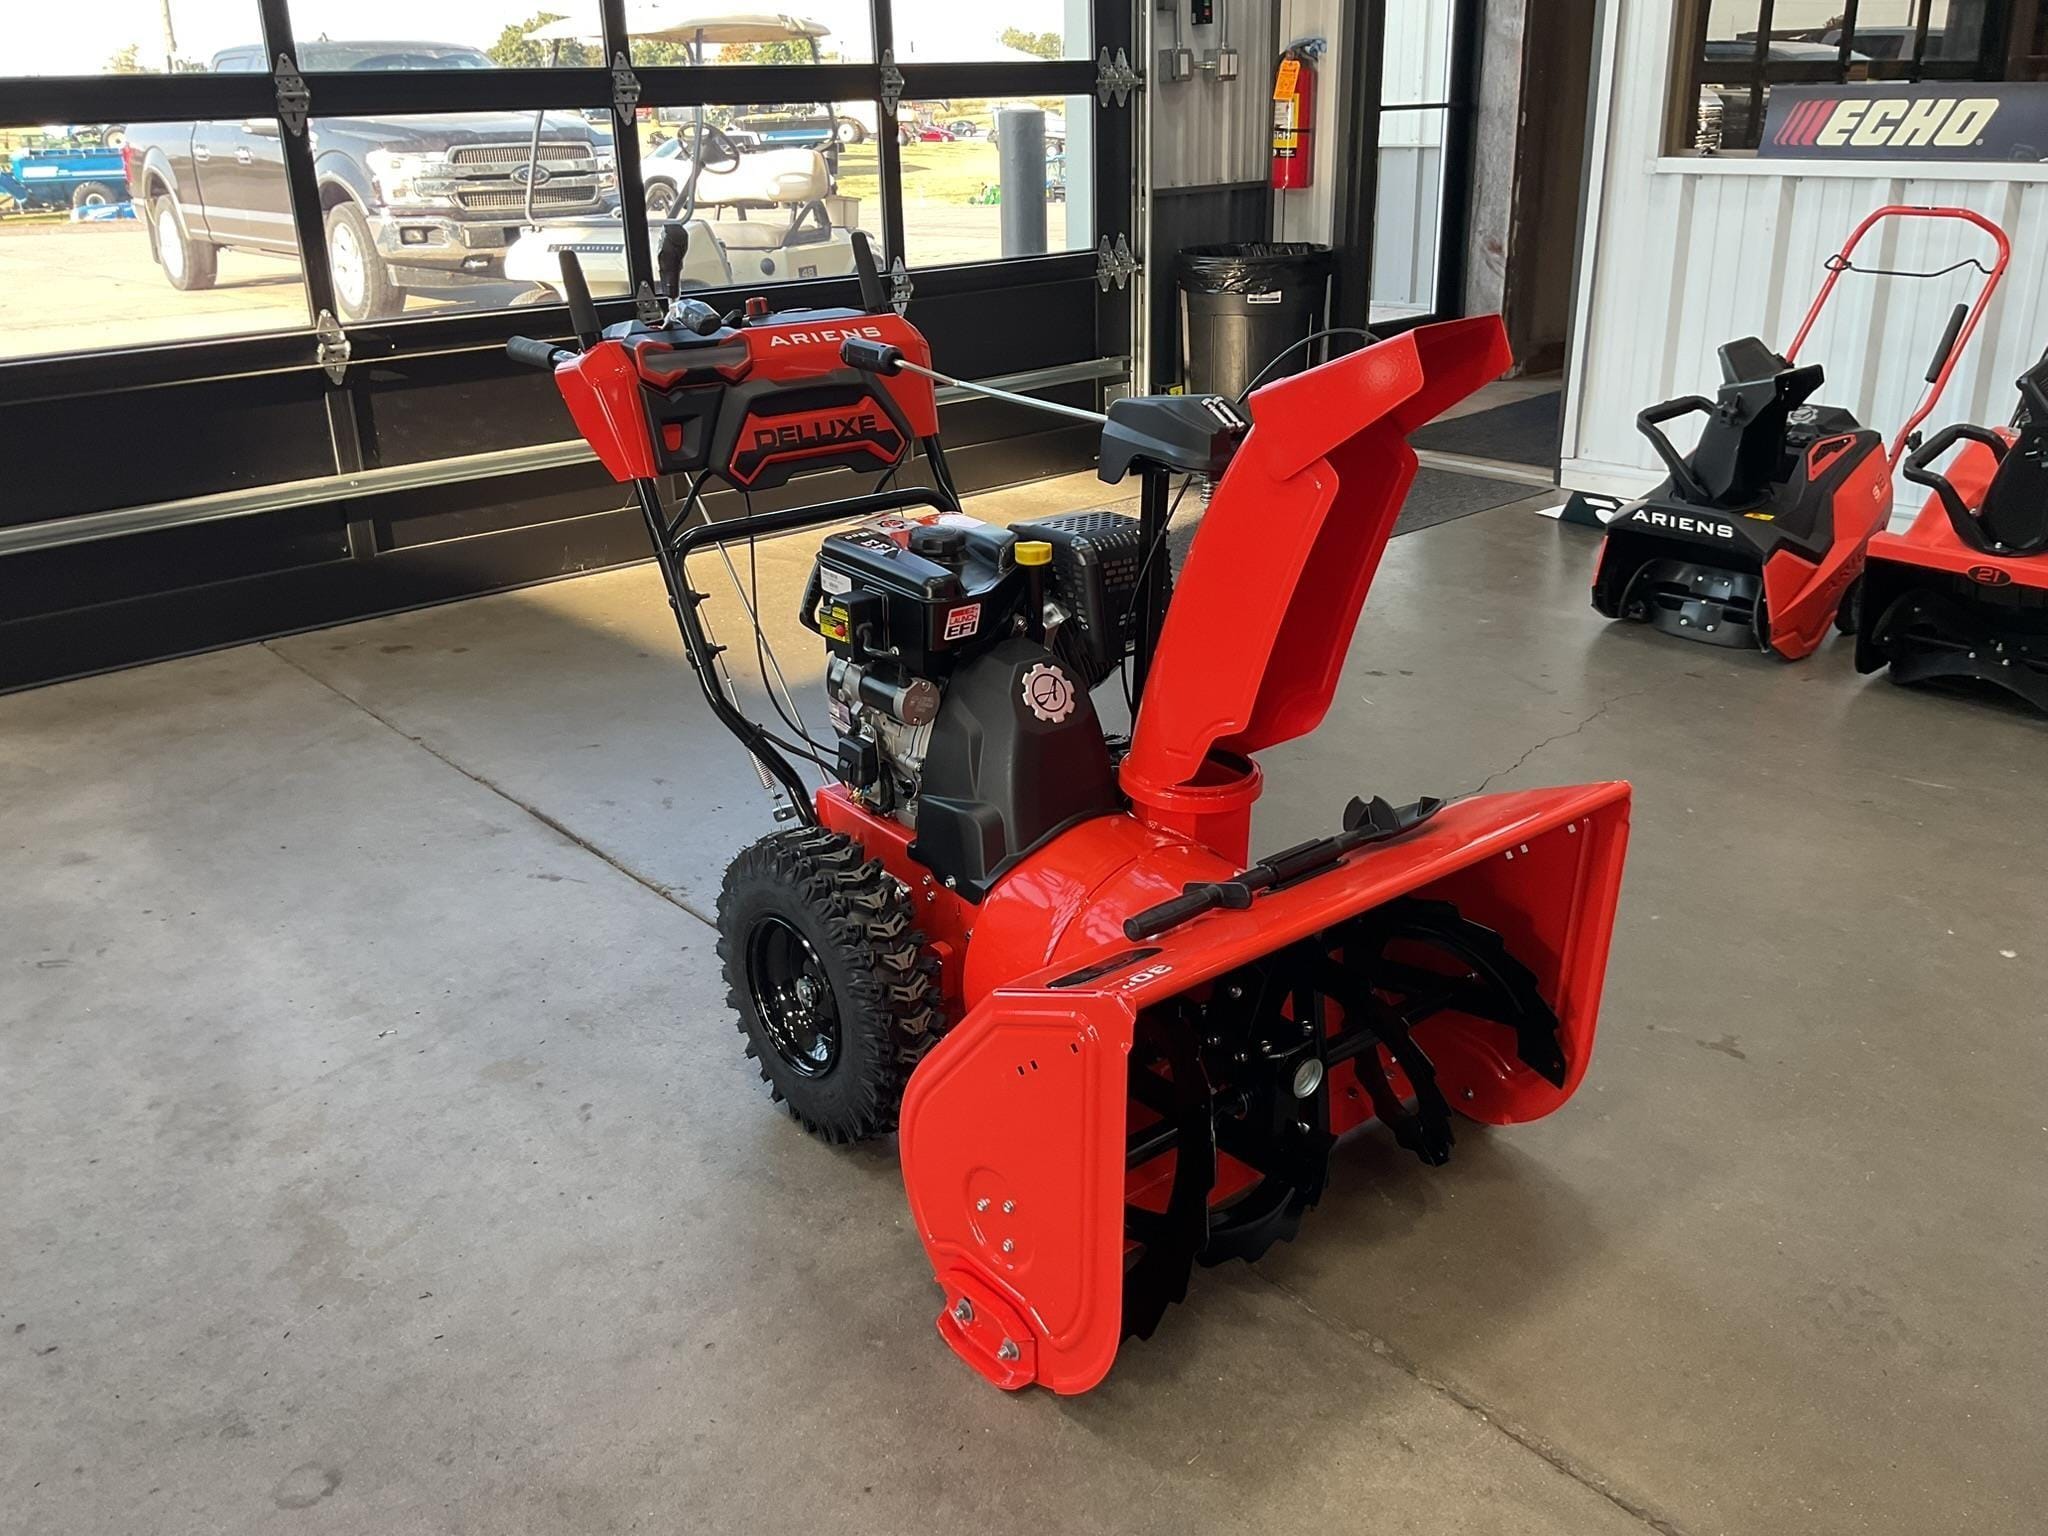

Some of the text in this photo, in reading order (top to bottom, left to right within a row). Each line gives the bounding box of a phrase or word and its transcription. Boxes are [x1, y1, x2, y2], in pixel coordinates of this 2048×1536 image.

[1816, 98, 2000, 146] ECHO
[770, 326, 882, 347] ARIENS
[753, 414, 877, 450] DELUXE
[1632, 509, 1734, 538] ARIENS
[1976, 568, 2000, 583] 21
[947, 621, 976, 637] EFI
